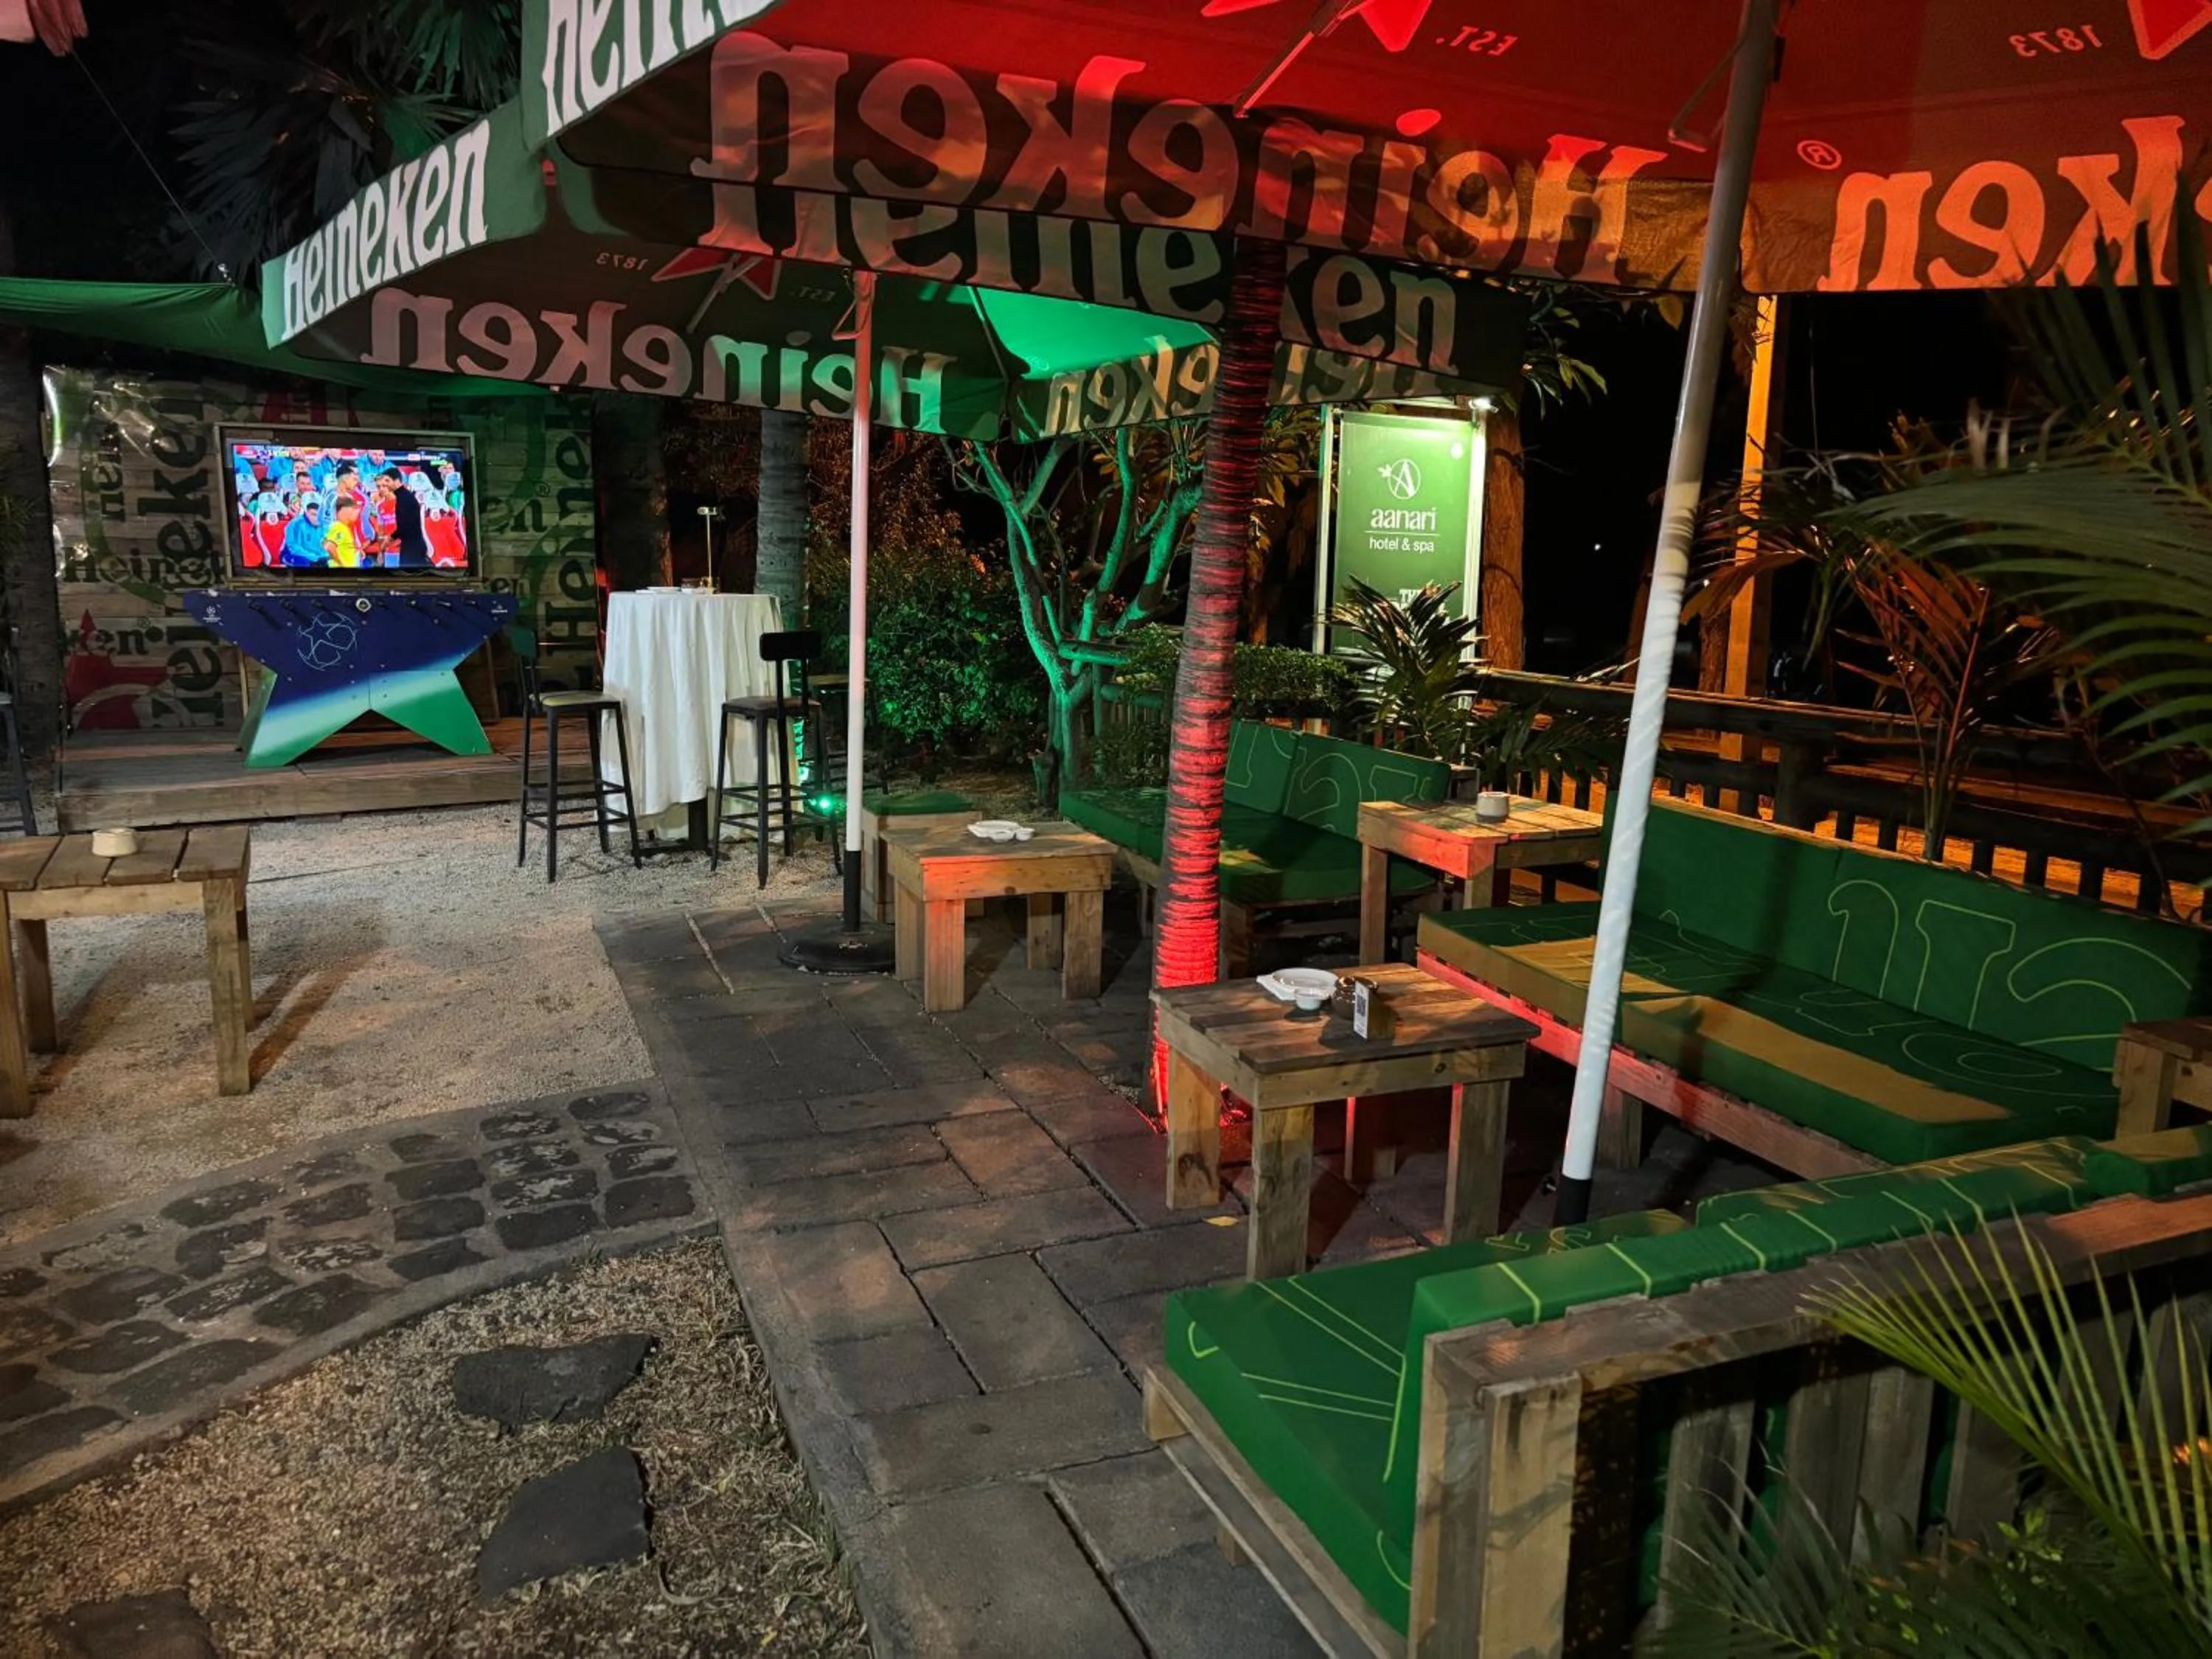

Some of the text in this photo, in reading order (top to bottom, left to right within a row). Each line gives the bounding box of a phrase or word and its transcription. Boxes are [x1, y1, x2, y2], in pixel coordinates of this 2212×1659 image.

[282, 118, 490, 341] Heineken
[1371, 507, 1437, 531] aanari
[1369, 536, 1434, 554] hotel & spa
